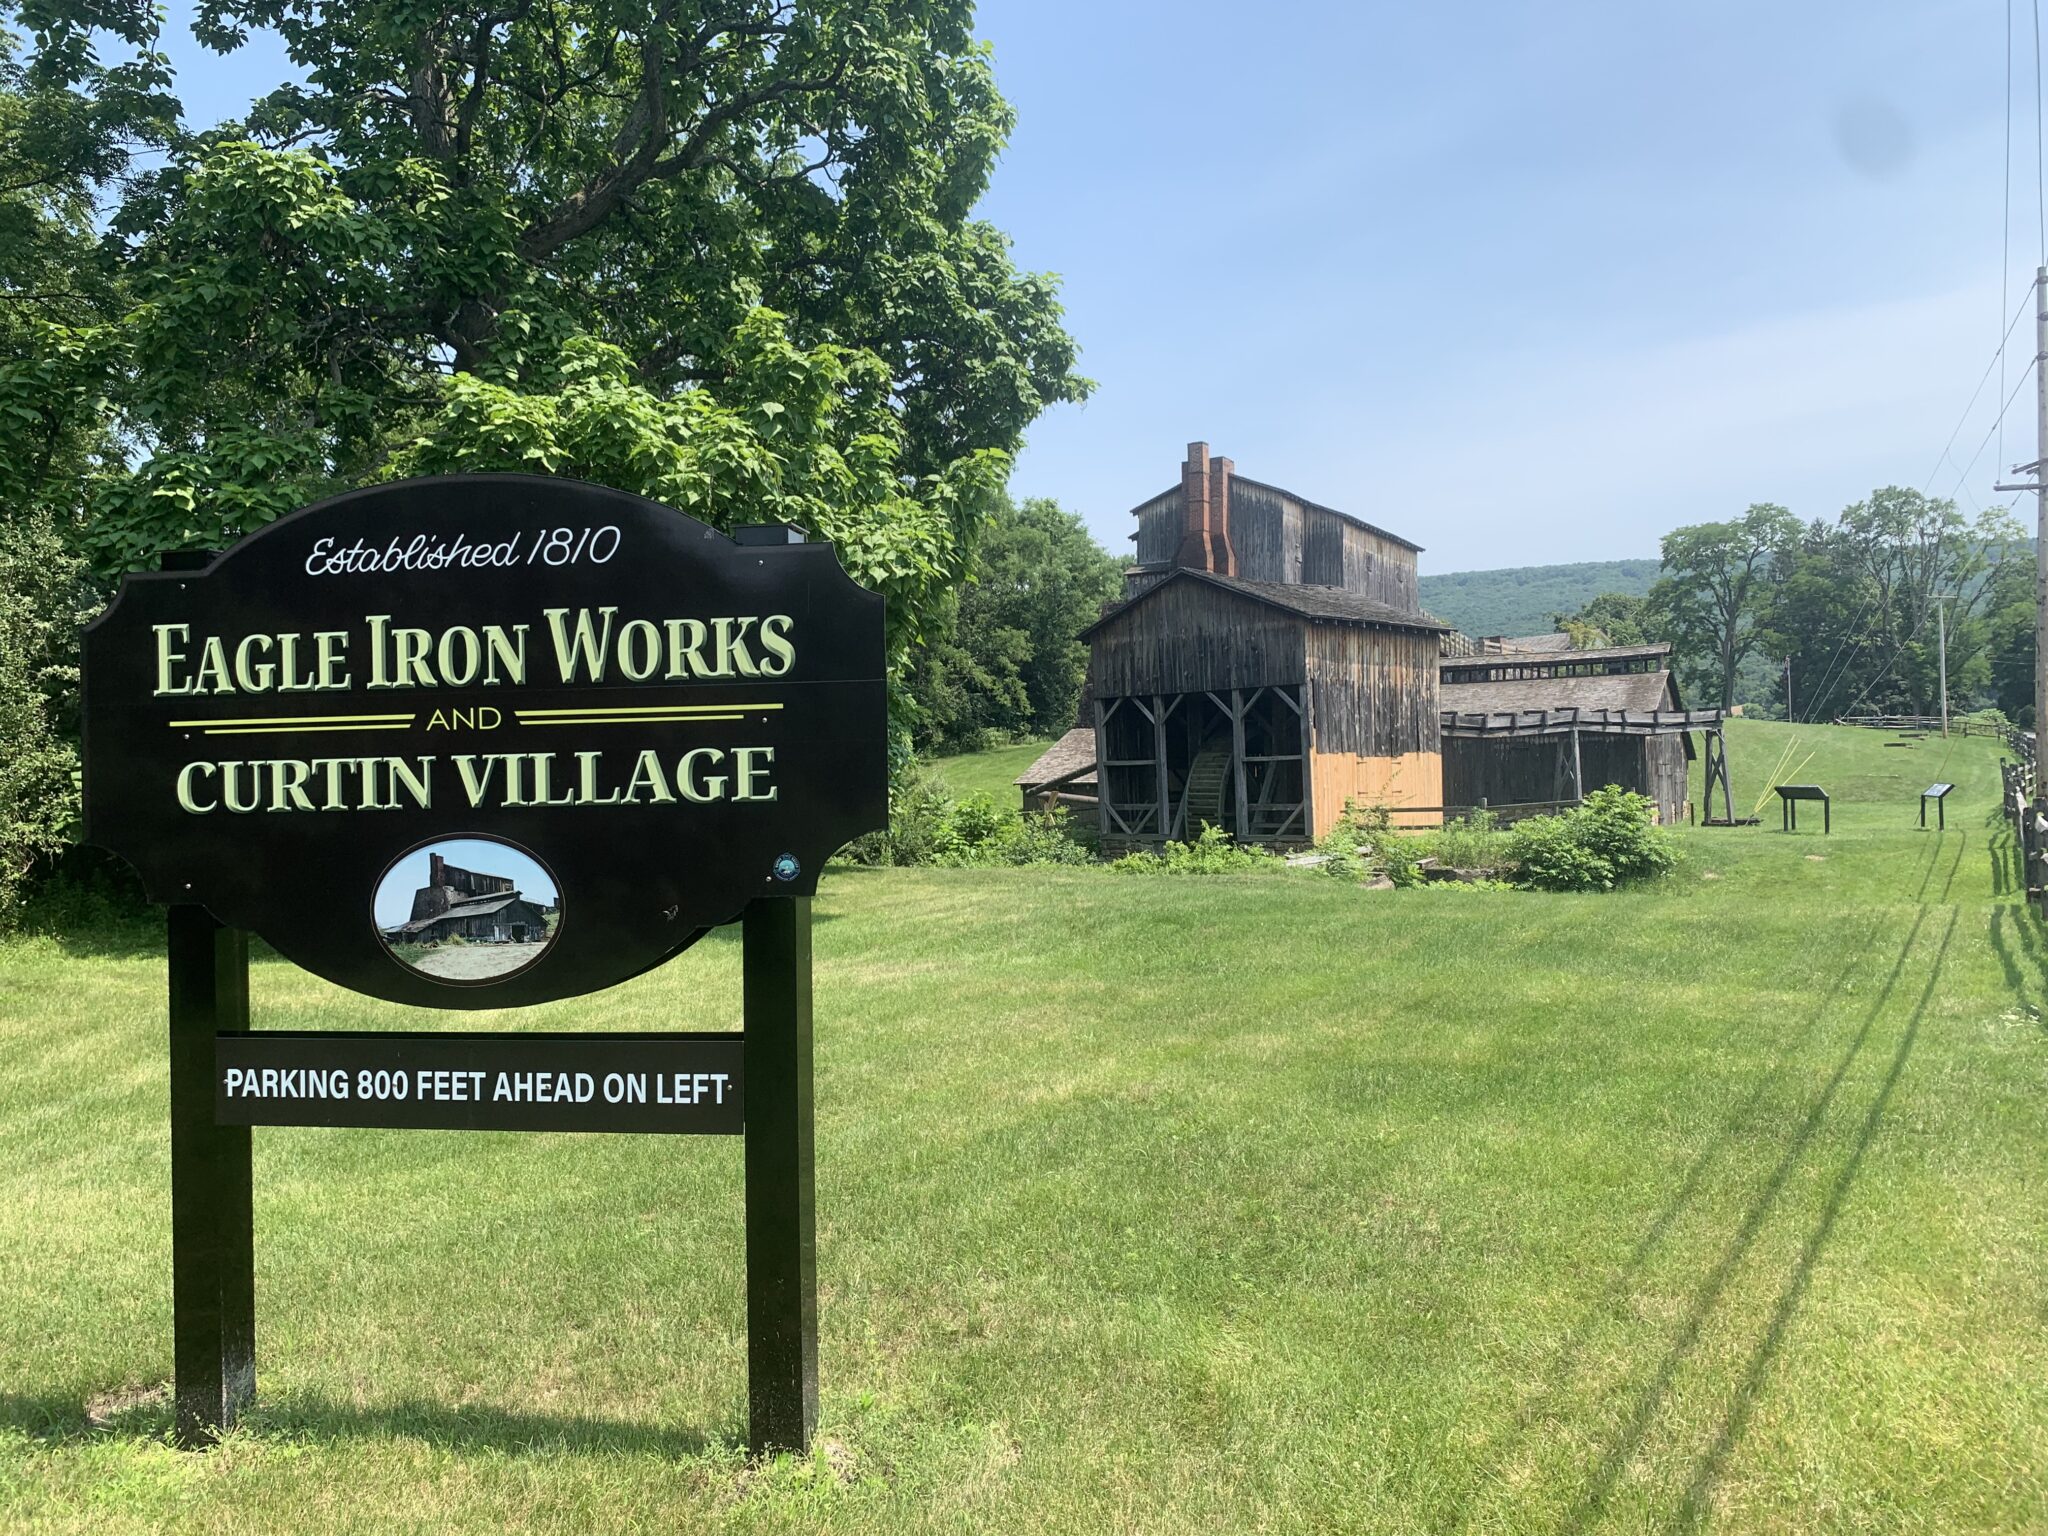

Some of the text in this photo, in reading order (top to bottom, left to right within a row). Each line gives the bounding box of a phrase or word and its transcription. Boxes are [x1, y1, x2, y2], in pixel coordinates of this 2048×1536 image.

[306, 526, 620, 575] Established 1810
[152, 607, 795, 697] EAGLE IRON WORKS
[426, 706, 501, 731] AND
[176, 747, 778, 814] CURTIN VILLAGE
[226, 1069, 728, 1104] PARKING 800 FEET AHEAD ON LEFT
